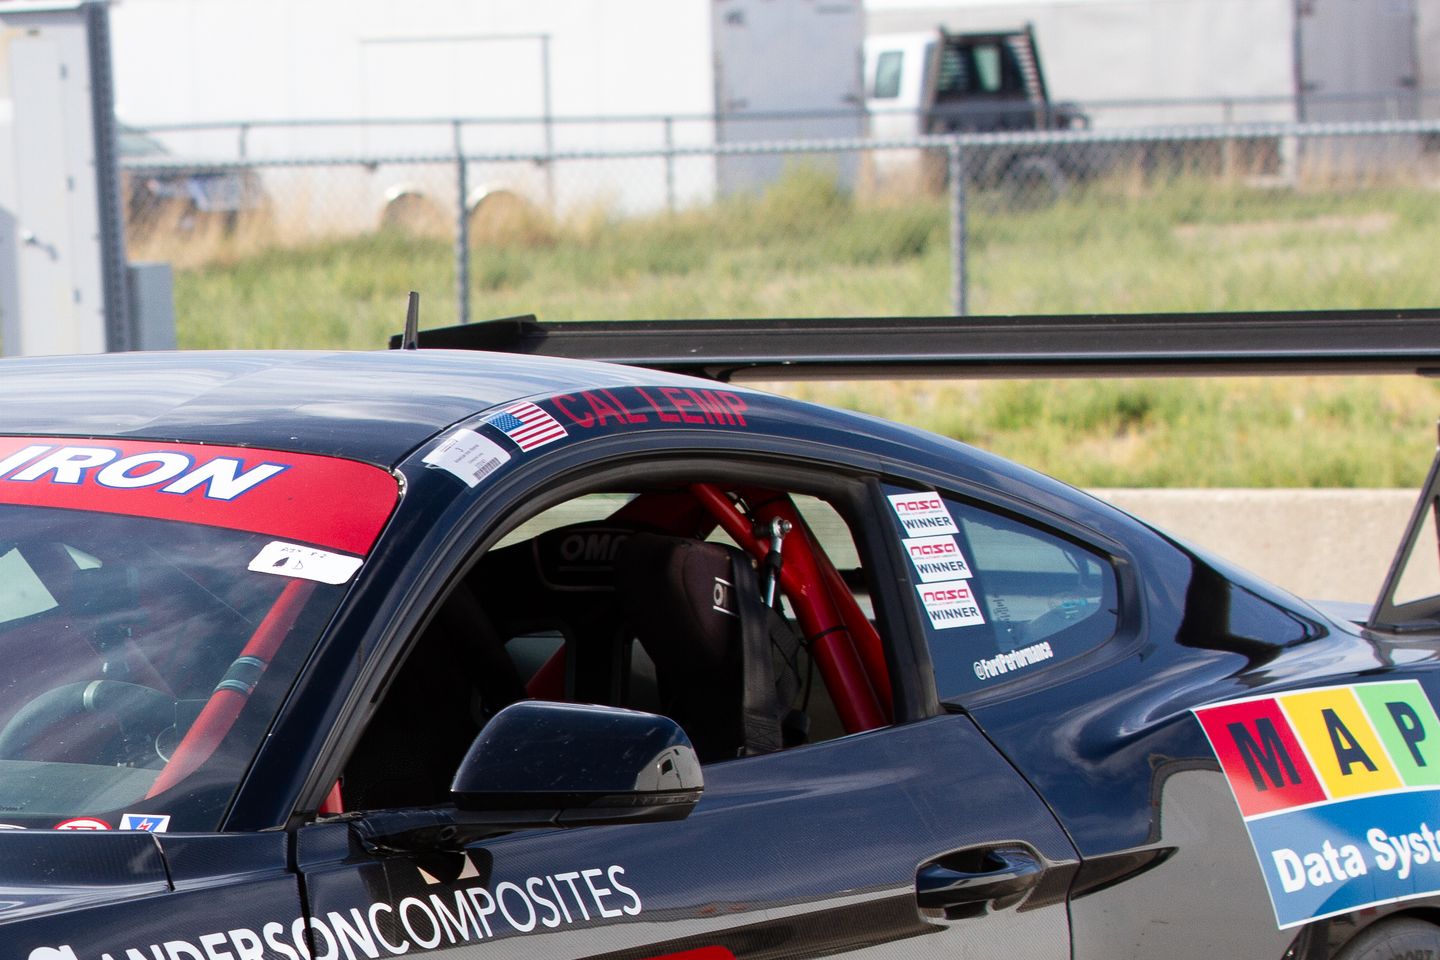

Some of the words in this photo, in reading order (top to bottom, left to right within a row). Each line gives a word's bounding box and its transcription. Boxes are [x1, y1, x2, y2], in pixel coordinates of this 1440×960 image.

[551, 387, 648, 428] CAL
[635, 386, 748, 427] LEMP
[896, 499, 941, 512] nasa
[903, 516, 952, 530] WINNER
[910, 542, 955, 555] nasa
[917, 560, 966, 574] WINNER
[924, 588, 969, 601] nasa
[929, 606, 979, 621] WINNER
[1271, 839, 1368, 893] Data
